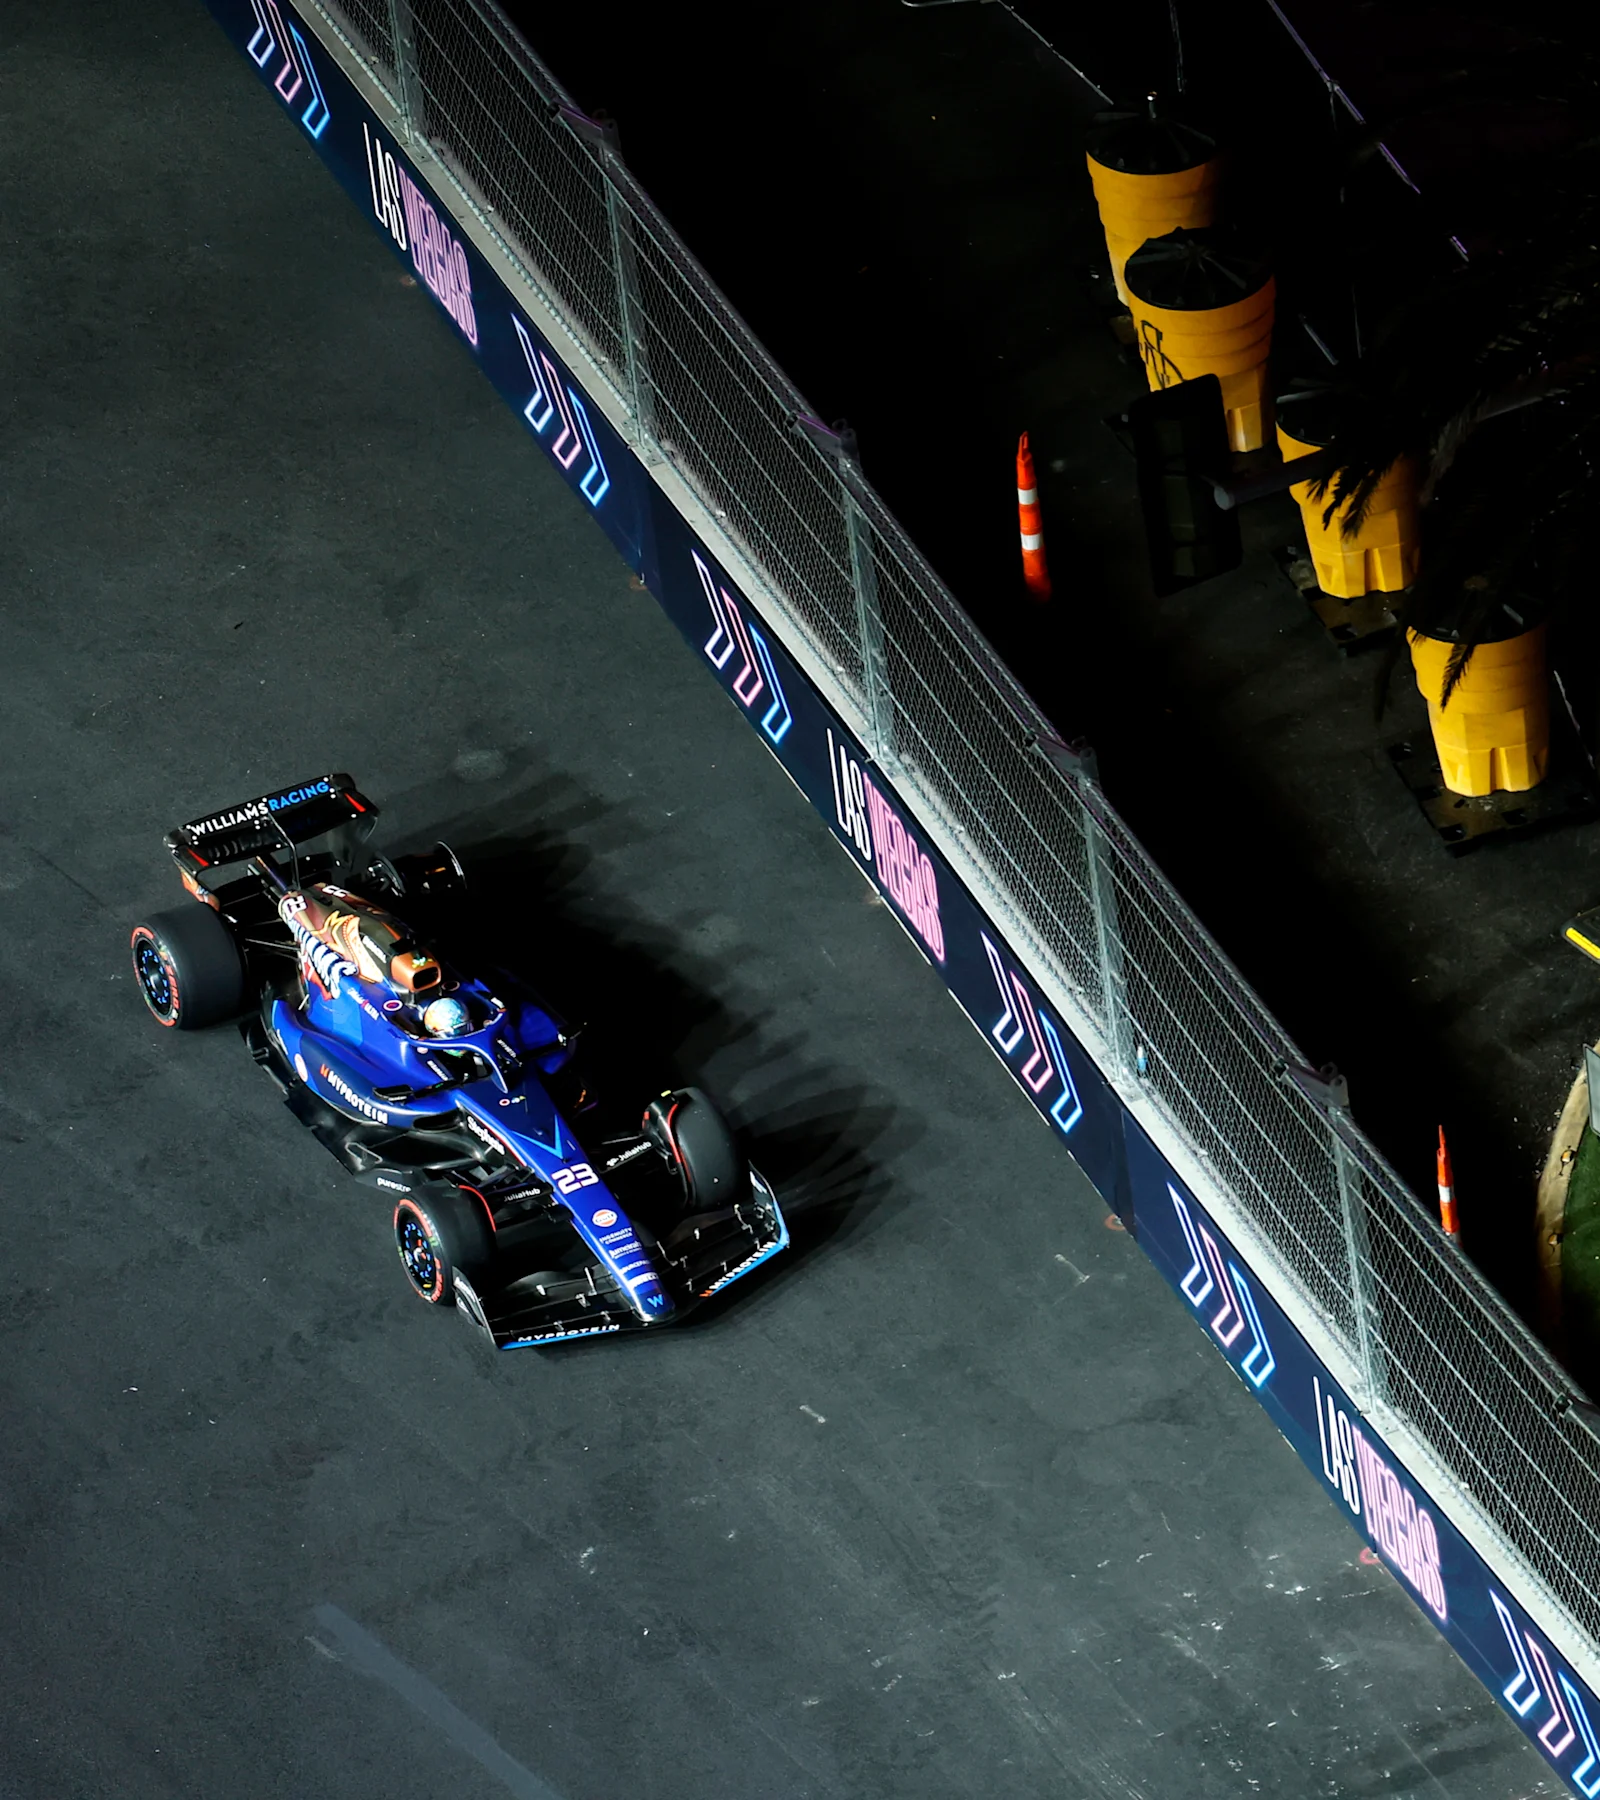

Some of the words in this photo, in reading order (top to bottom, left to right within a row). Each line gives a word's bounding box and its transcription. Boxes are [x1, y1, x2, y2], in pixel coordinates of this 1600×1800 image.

[362, 121, 408, 252] LAS
[398, 165, 479, 347] VEGAS
[190, 802, 269, 837] WILLIAMS
[267, 781, 330, 812] RACING
[827, 728, 873, 861] LAS
[862, 771, 946, 963] VEGAS
[327, 1070, 389, 1125] MYPROTEIN
[504, 1187, 541, 1202] JuliaHub
[551, 1162, 600, 1195] 23
[517, 1323, 621, 1343] MYPROTEIN
[1313, 1376, 1361, 1515] LAS
[1352, 1424, 1448, 1620] VEGAS
